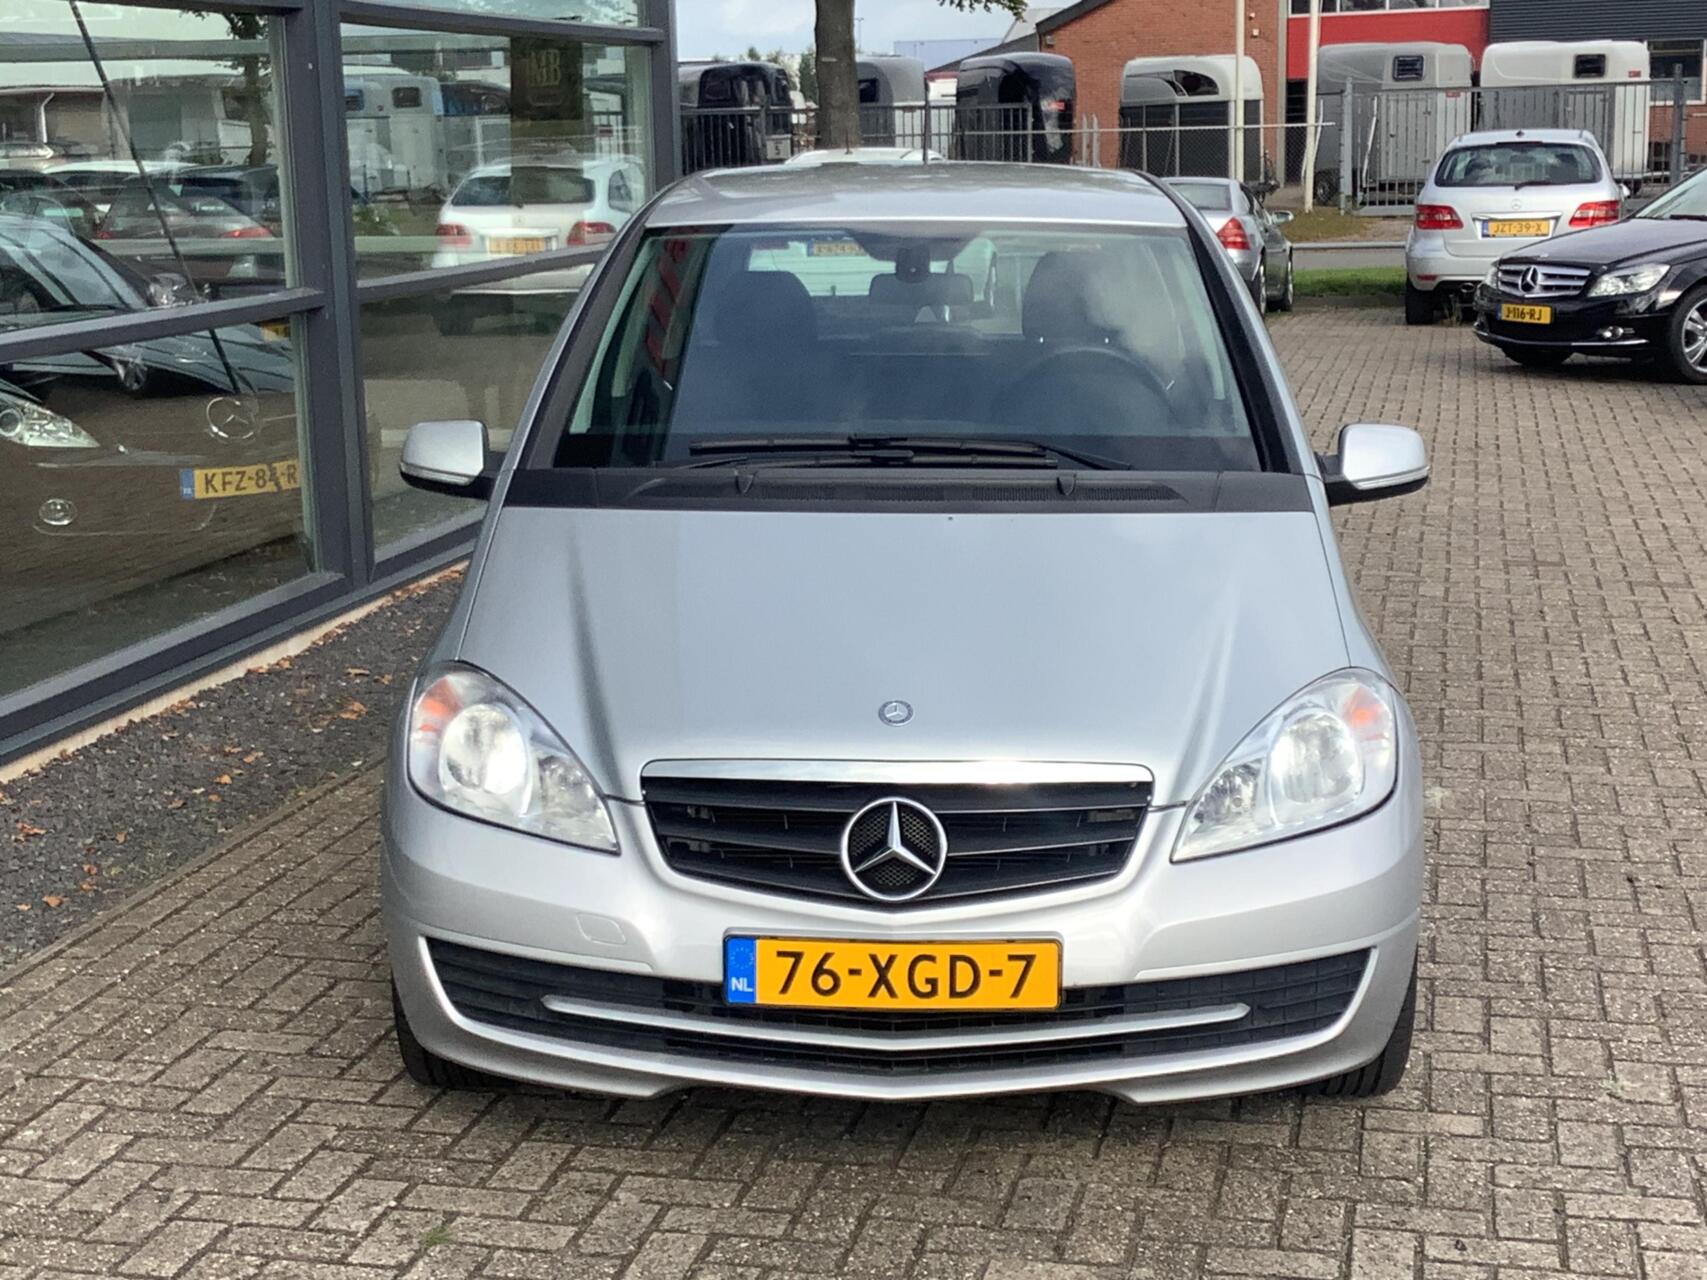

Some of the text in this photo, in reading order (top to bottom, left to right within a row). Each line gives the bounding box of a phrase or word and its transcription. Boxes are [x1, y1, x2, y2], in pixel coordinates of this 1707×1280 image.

[1493, 222, 1543, 234] JZT-39-X
[1505, 306, 1544, 321] J-116-RJ
[731, 949, 1037, 1000] NL 76-XGD-7
